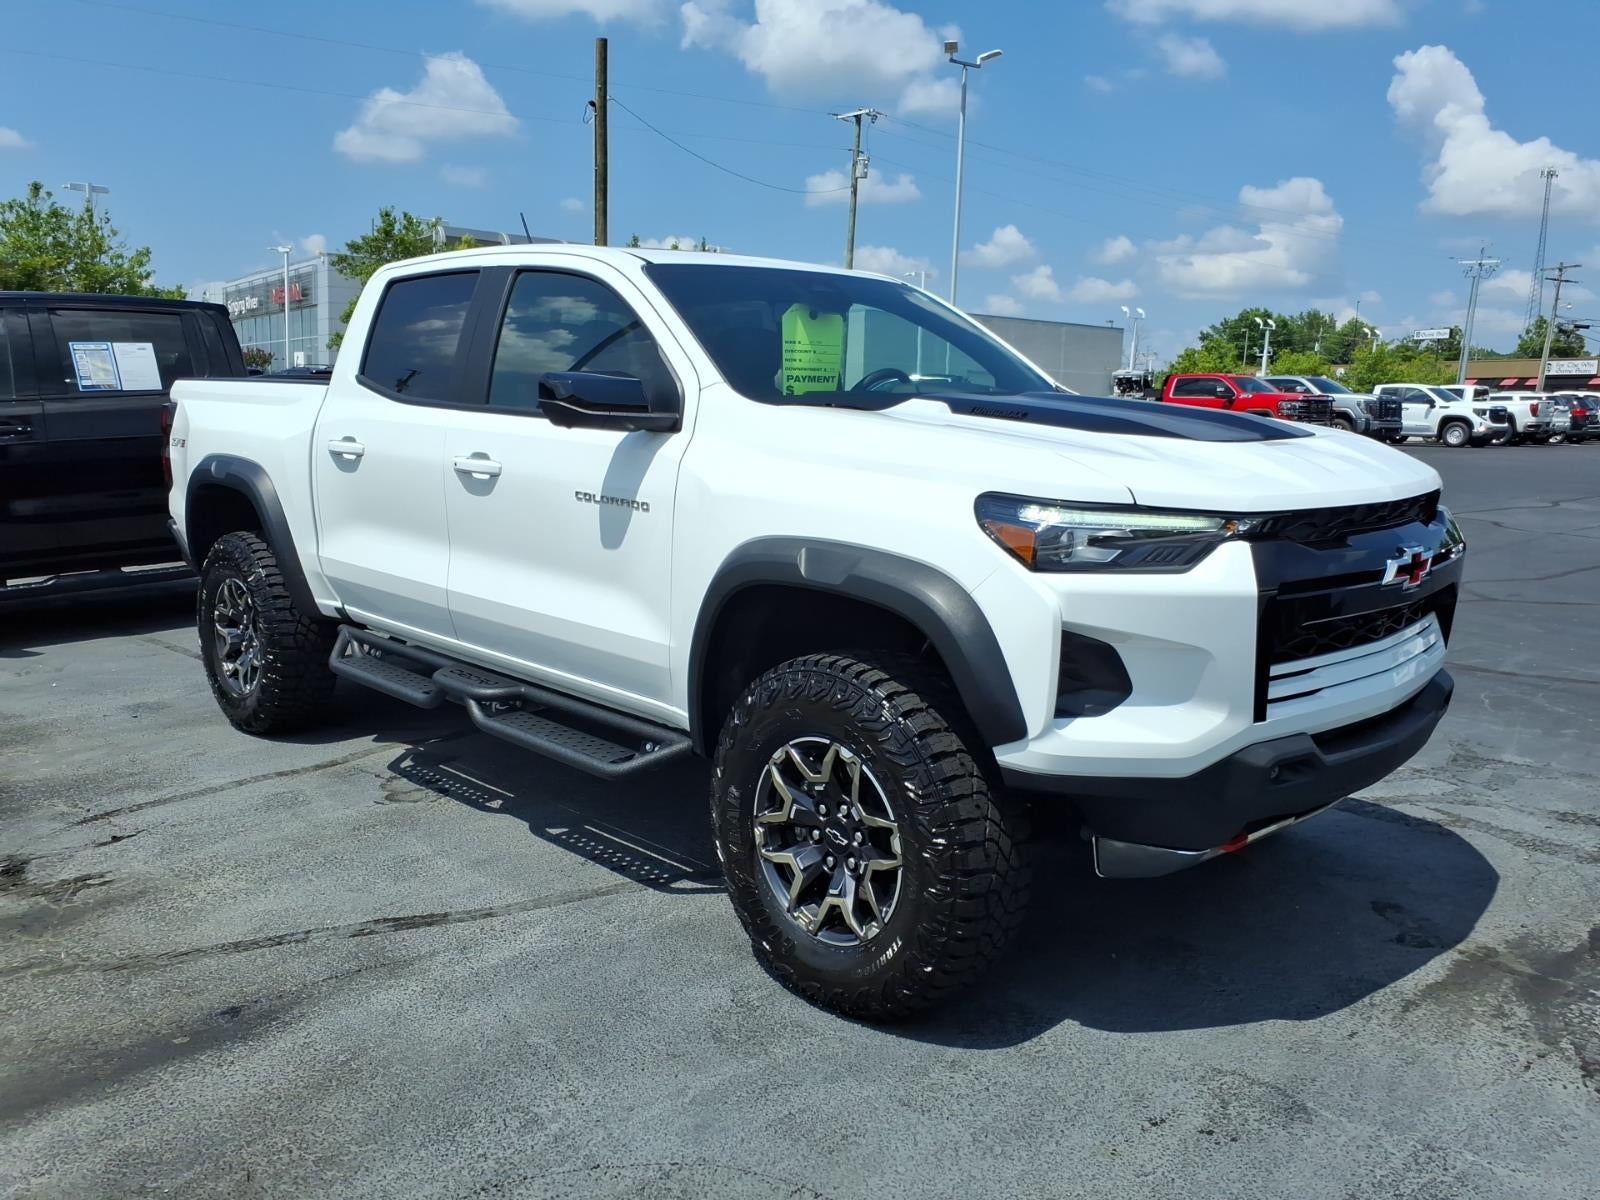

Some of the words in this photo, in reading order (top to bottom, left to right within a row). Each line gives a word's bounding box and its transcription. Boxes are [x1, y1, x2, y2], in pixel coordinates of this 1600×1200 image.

[245, 295, 258, 310] River
[271, 282, 303, 305] NISAN
[786, 375, 837, 384] PAYMENT
[574, 490, 650, 513] COLORADO
